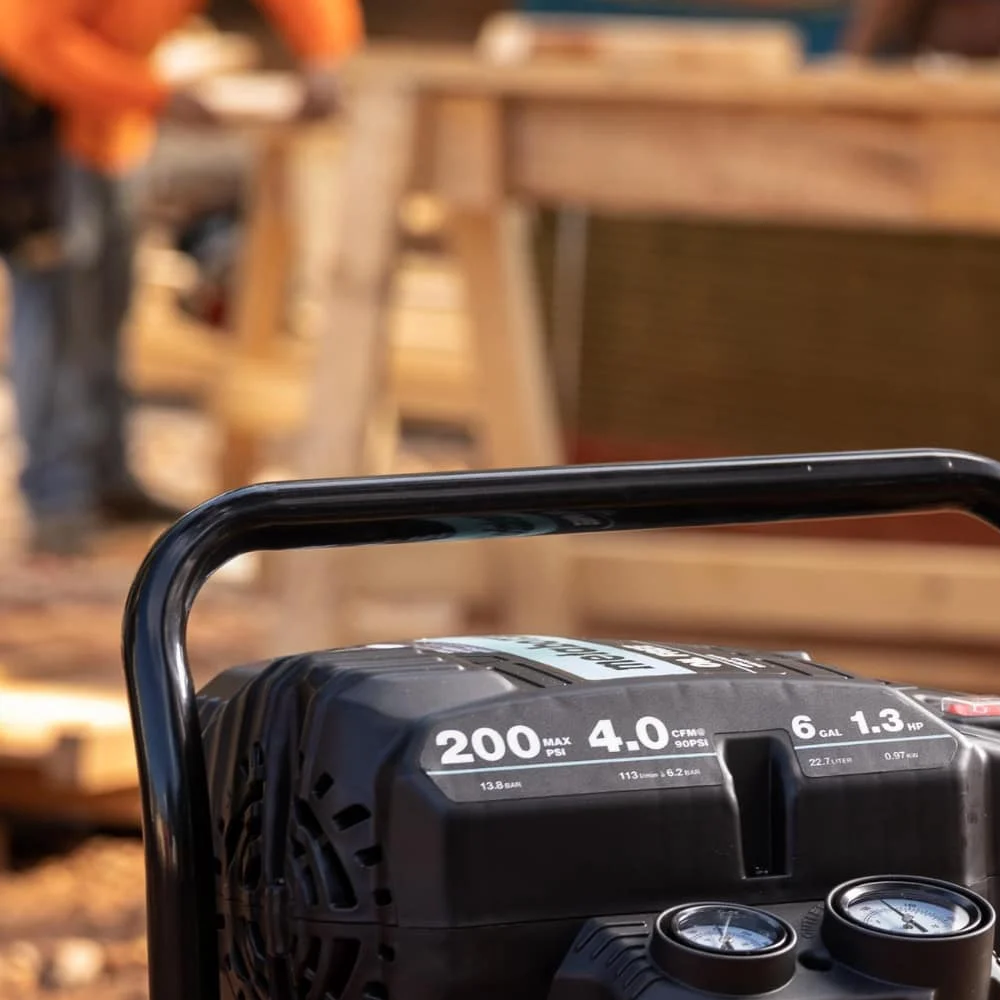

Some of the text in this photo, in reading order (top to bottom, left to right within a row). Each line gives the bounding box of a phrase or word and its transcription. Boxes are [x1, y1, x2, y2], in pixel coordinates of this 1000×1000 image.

[588, 716, 669, 752] 4.0
[791, 714, 843, 740] 6 GAL
[850, 708, 924, 735] 1.3 HP
[435, 725, 572, 765] 200 MAX
[546, 748, 567, 758] PSI
